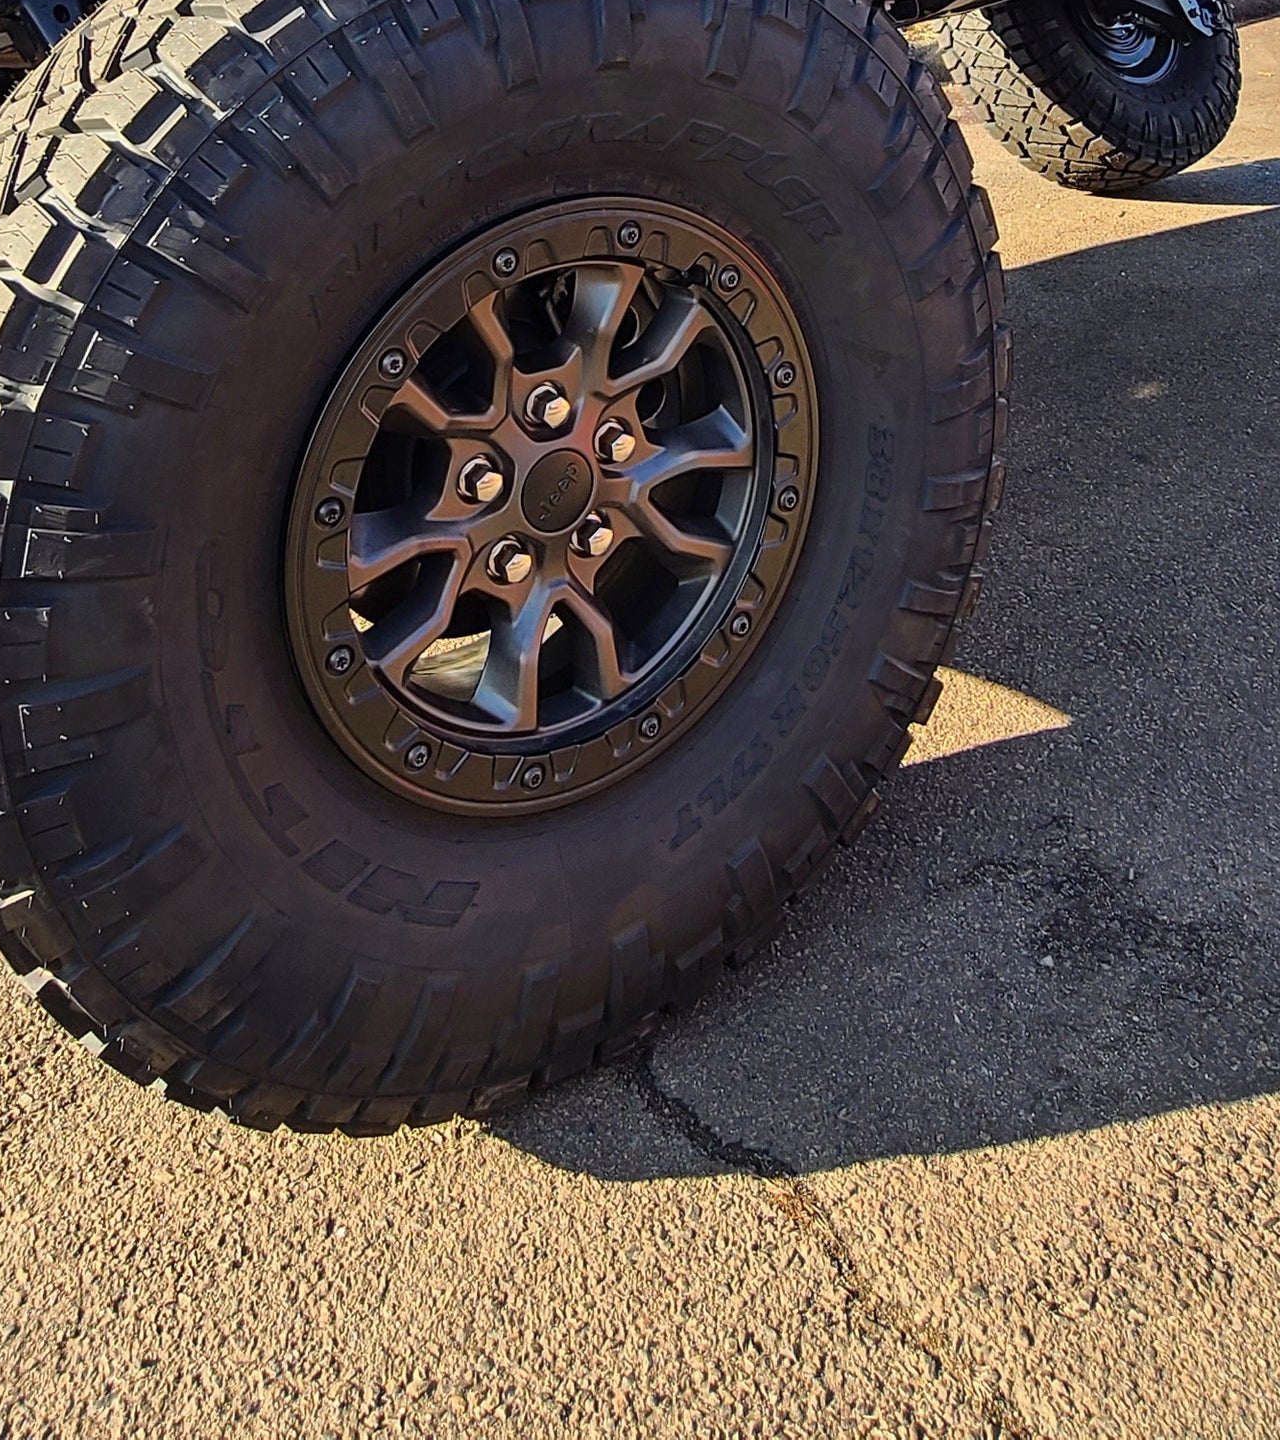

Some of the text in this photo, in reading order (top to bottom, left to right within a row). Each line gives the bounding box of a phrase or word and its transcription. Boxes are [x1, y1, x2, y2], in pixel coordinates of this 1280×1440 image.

[525, 111, 842, 243] GRAPPLER
[539, 461, 580, 522] Jeep
[196, 539, 482, 928] NITTO
